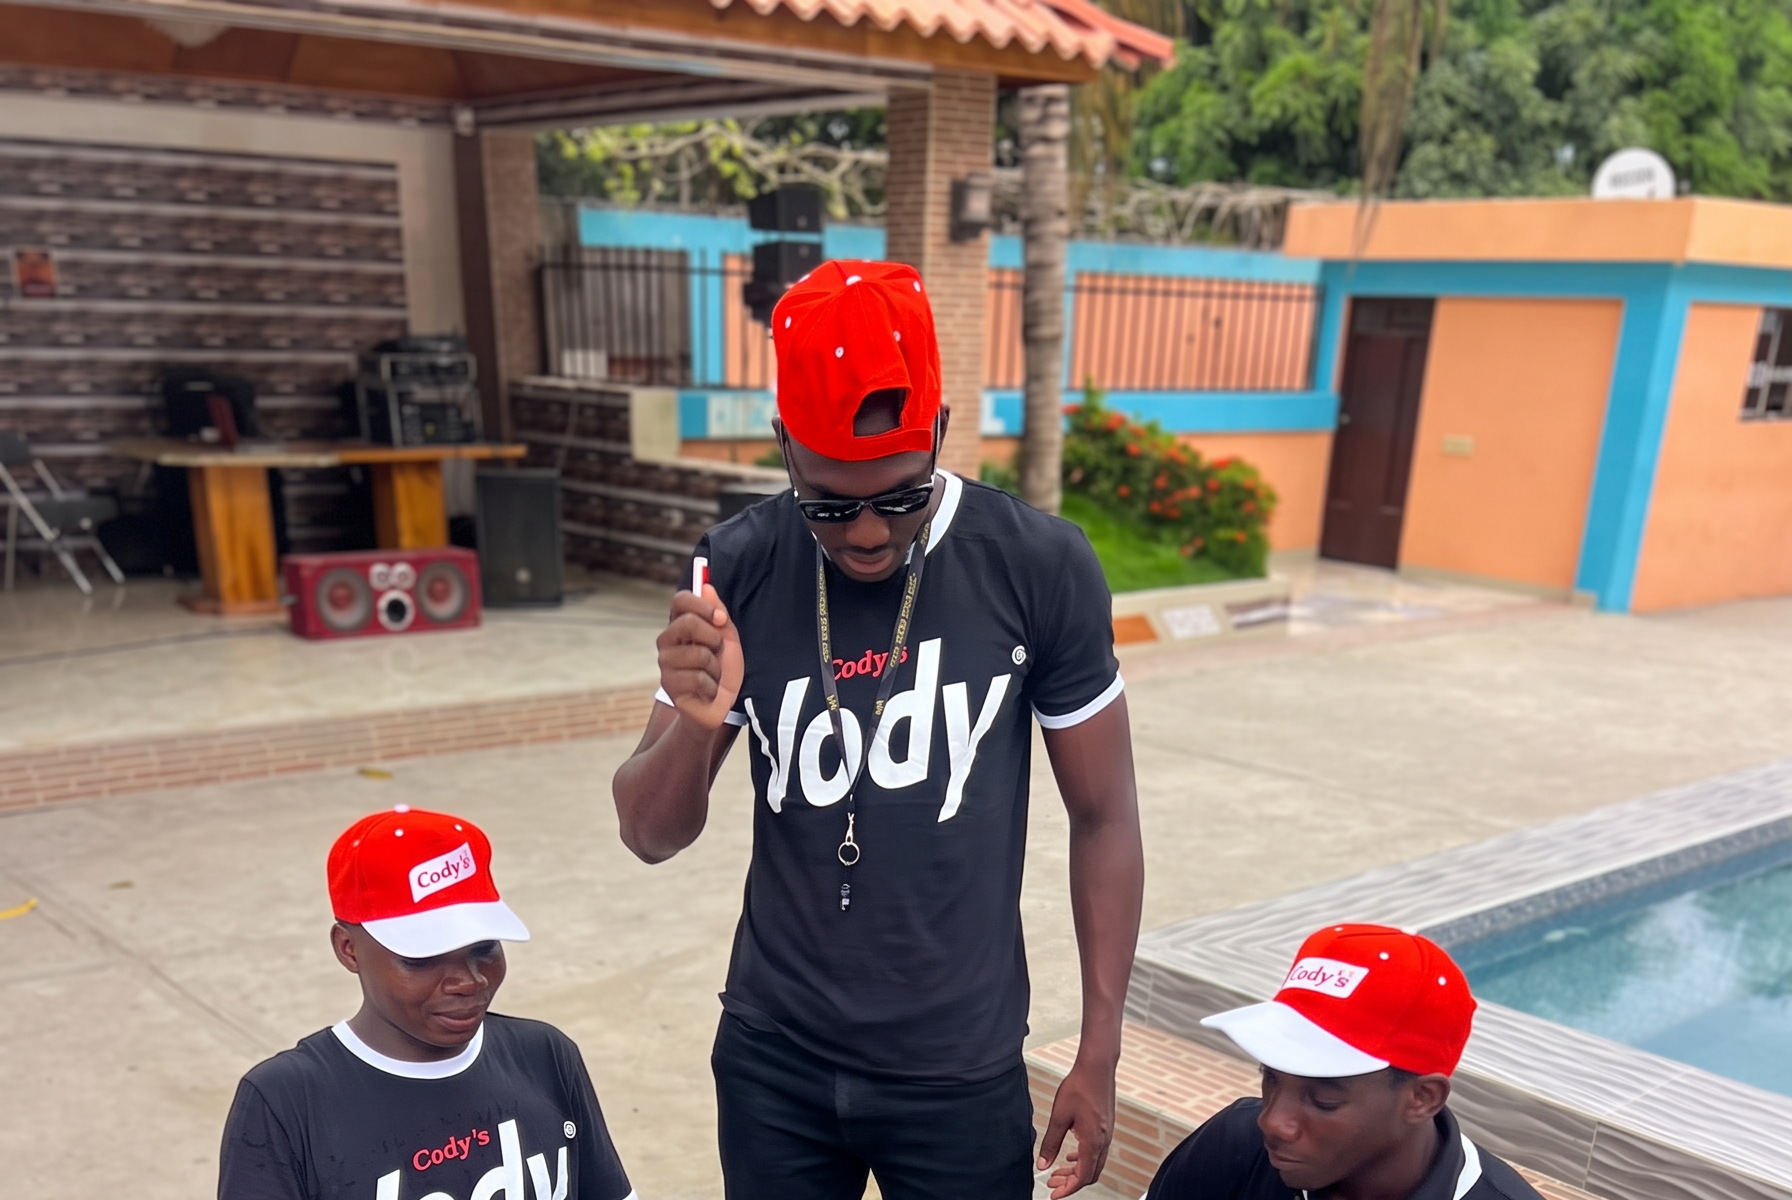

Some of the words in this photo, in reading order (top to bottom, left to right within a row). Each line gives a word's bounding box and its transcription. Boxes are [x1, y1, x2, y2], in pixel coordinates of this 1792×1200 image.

[832, 646, 908, 681] Codys
[744, 637, 1011, 823] Vody
[417, 854, 470, 888] Cody's
[1289, 965, 1349, 988] Cody's
[412, 1129, 490, 1171] Cody's
